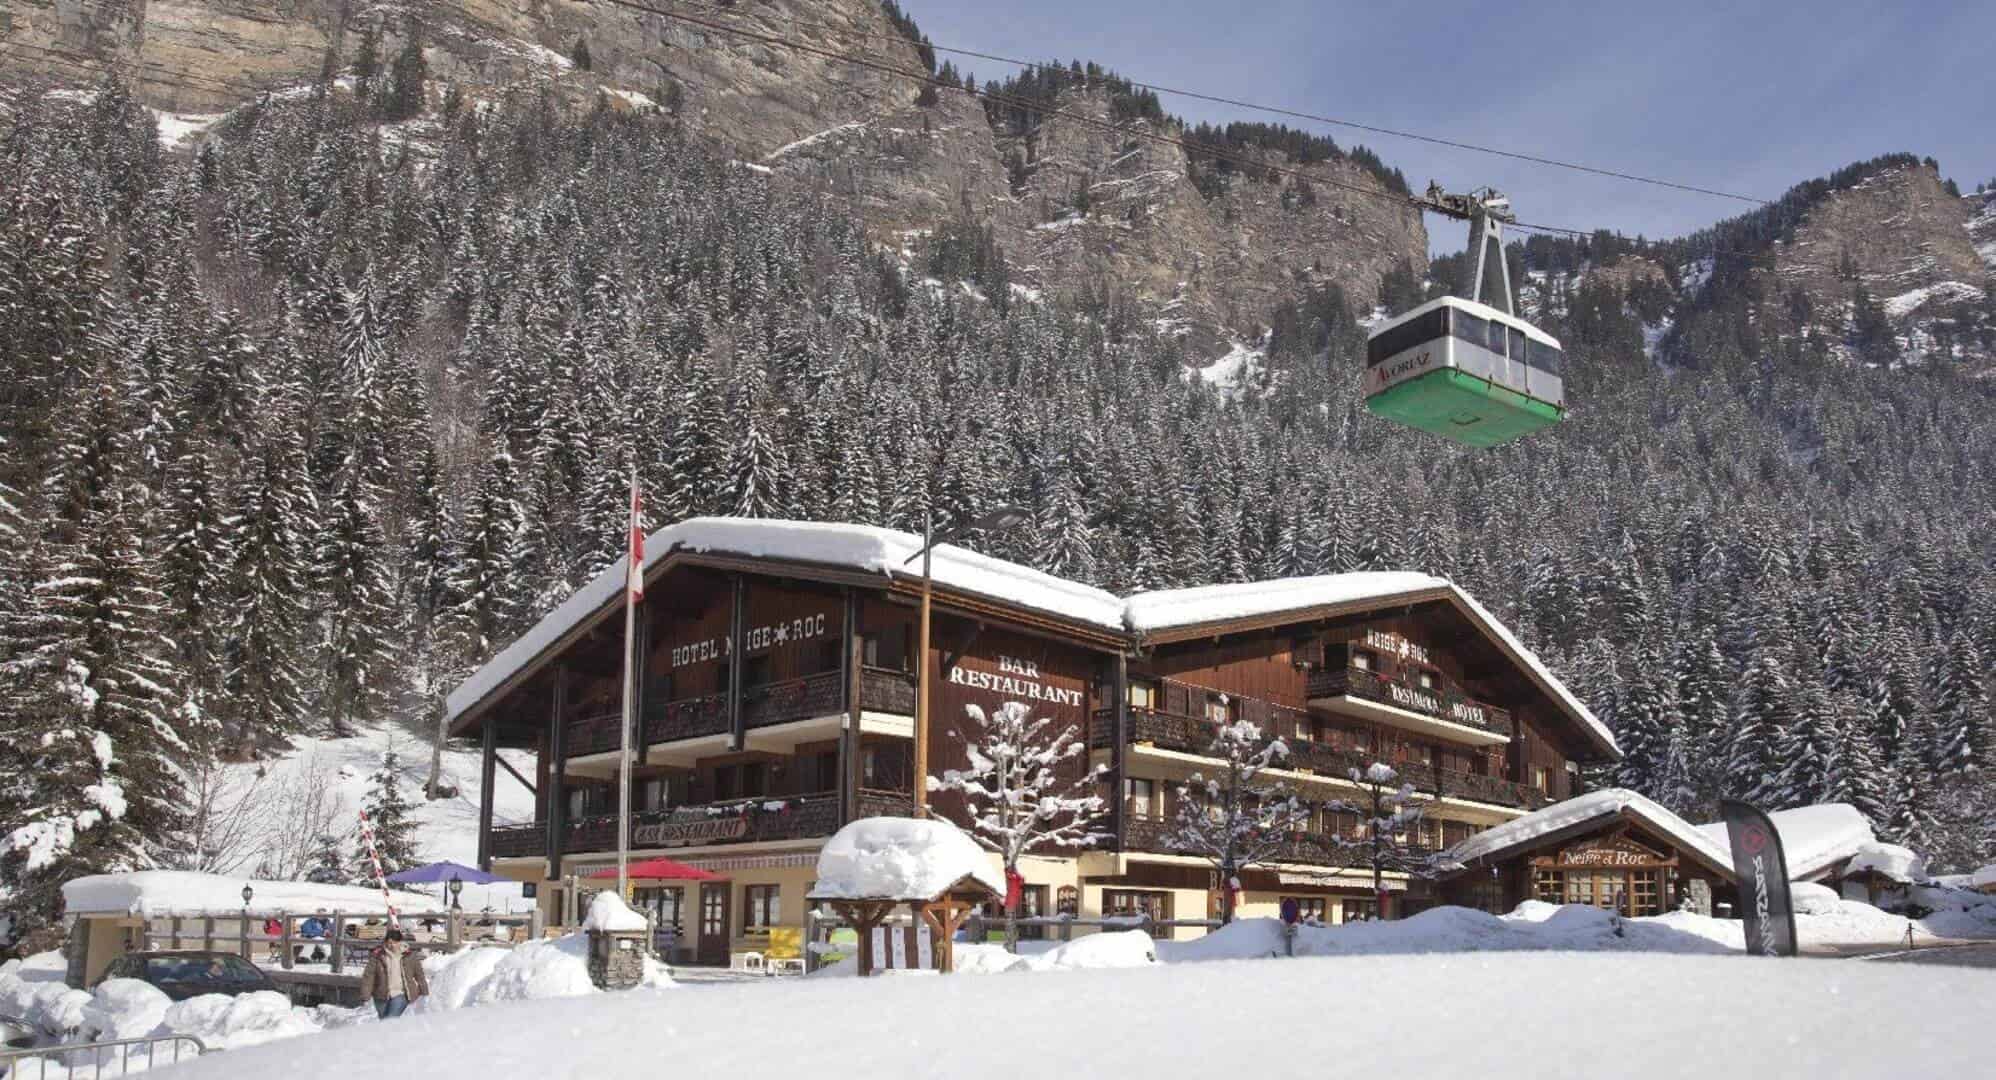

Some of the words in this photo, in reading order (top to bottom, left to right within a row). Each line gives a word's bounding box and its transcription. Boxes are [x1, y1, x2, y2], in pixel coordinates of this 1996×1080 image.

[672, 639, 719, 667] HOTEL
[725, 626, 771, 656] NIGE
[793, 613, 825, 640] ROC
[1367, 628, 1397, 652] NEIGE
[999, 655, 1040, 678] BAR
[949, 665, 1083, 706] RESTAURANT
[1452, 703, 1488, 725] HOTEL
[1564, 851, 1601, 865] Neige
[1615, 851, 1648, 865] Roc
